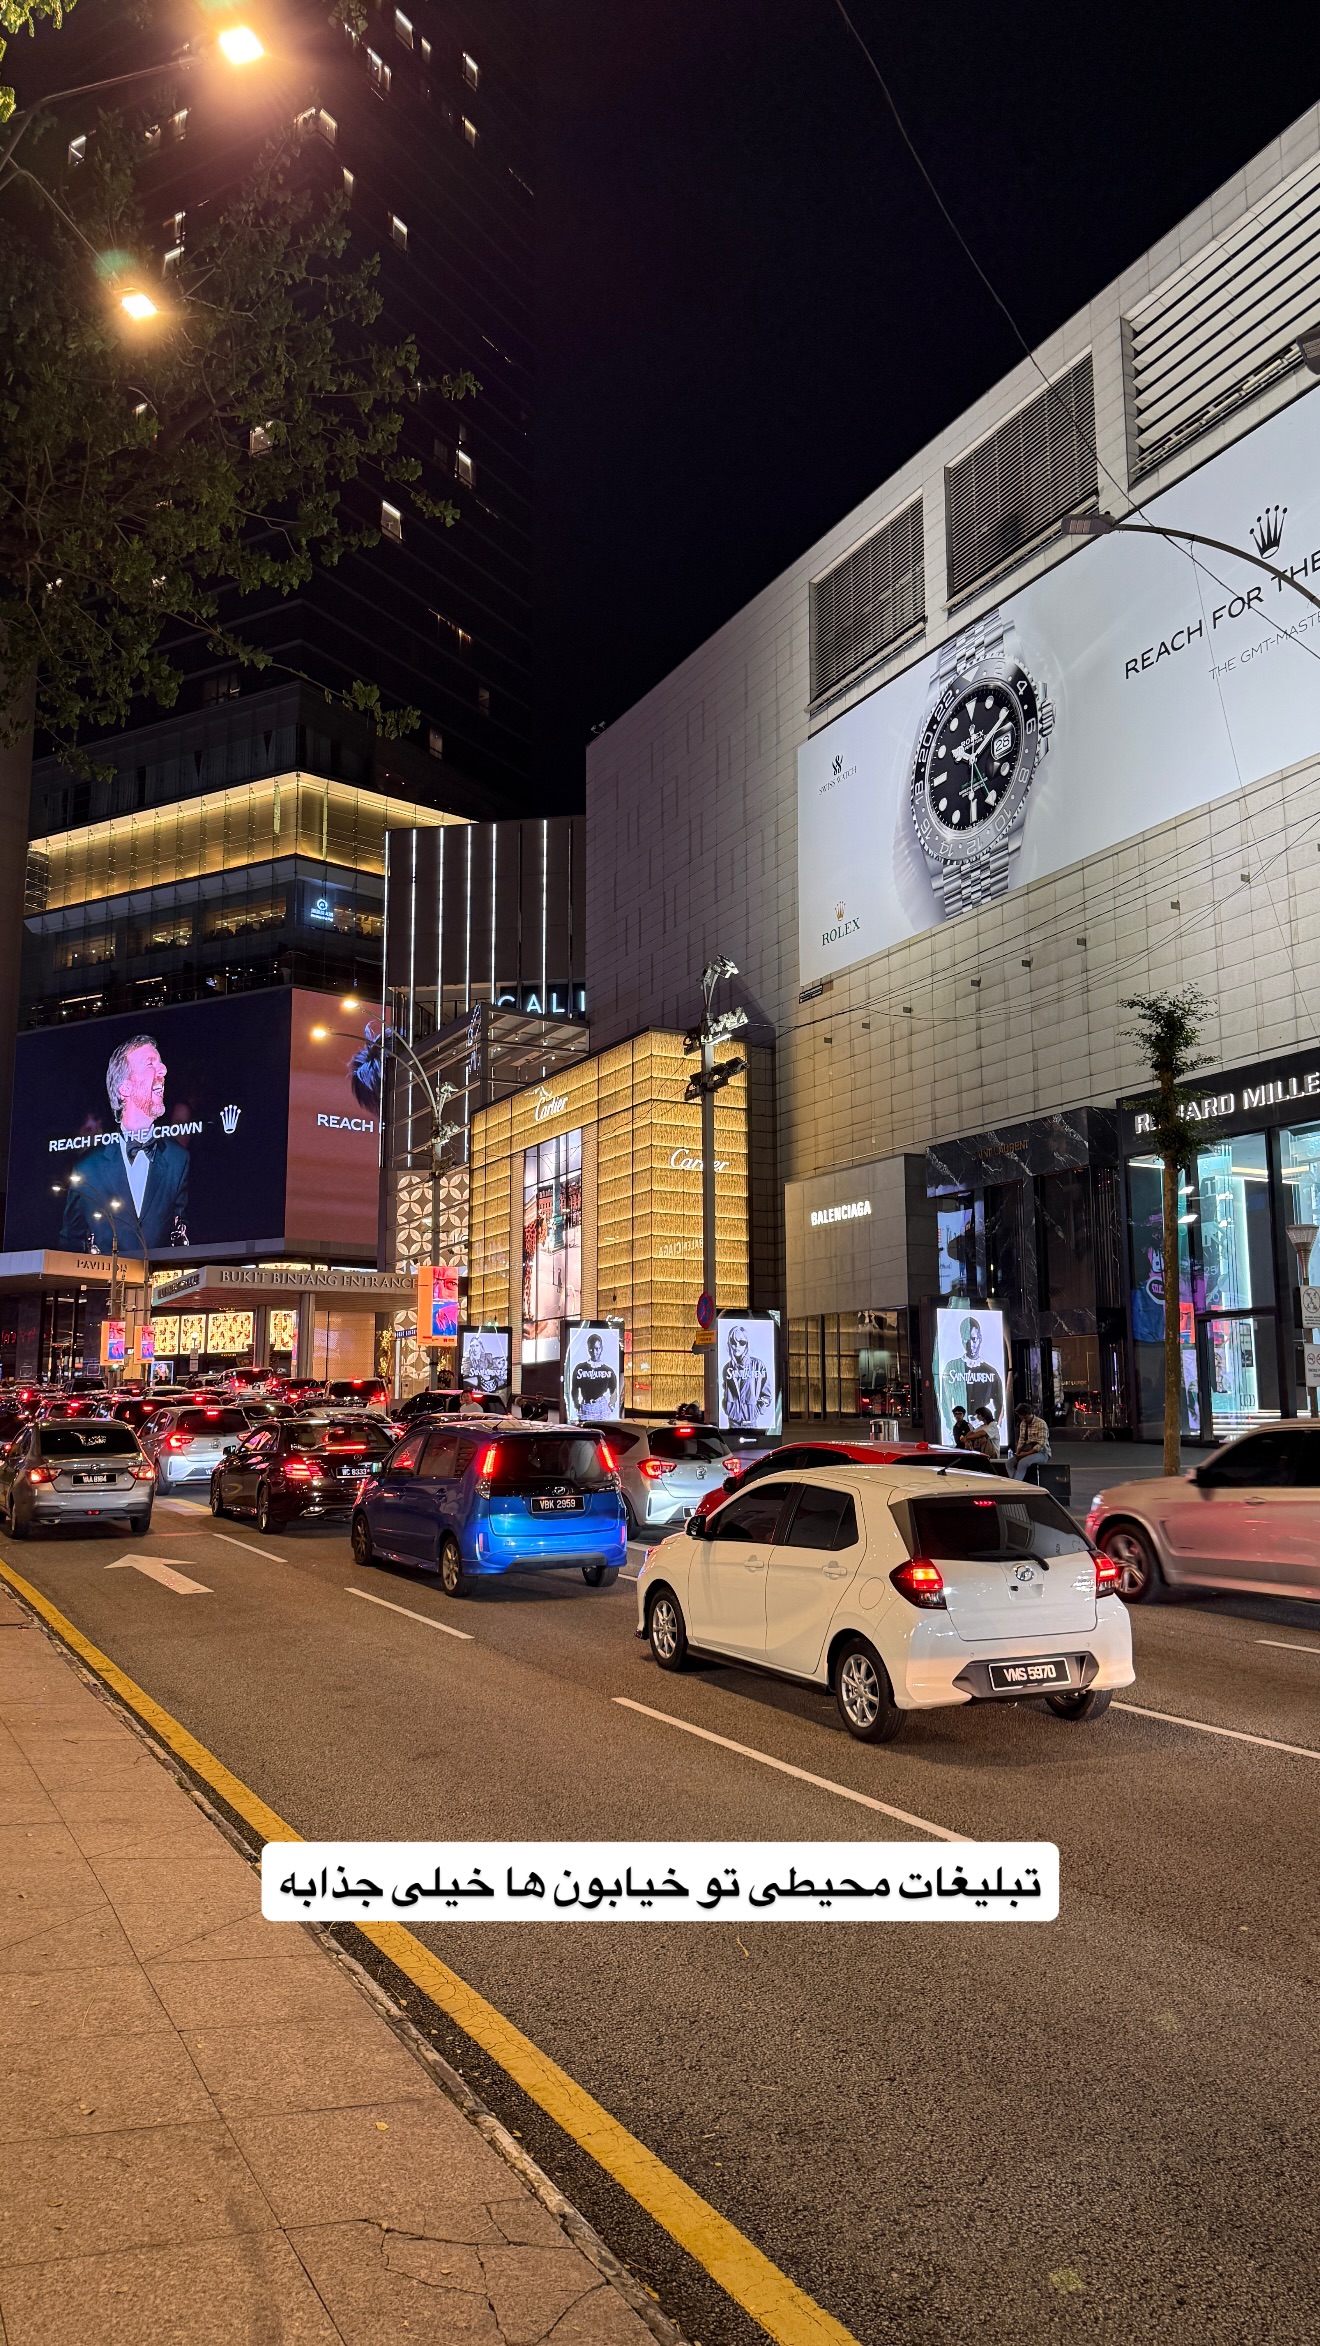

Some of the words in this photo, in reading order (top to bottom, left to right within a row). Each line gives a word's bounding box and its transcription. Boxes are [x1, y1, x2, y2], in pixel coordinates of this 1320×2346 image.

[1125, 619, 1203, 680] REACH
[1212, 586, 1264, 629] FOR
[1208, 657, 1236, 680] THE
[1241, 611, 1320, 663] GMT-MAST
[1016, 680, 1028, 696] 4
[935, 690, 955, 722] 22
[918, 732, 934, 763] 20
[995, 738, 1010, 752] 28
[821, 917, 861, 947] ROLEX
[535, 1096, 569, 1122] Cartier
[317, 1113, 374, 1133] REACH
[48, 1135, 91, 1152] REACH
[94, 1133, 120, 1147] FOR
[124, 1128, 150, 1141] THE
[152, 1121, 203, 1139] CROWN
[670, 1148, 730, 1172] Carer
[810, 1200, 872, 1227] BALENCIAGA
[220, 1270, 269, 1284] BUKIT
[273, 1271, 338, 1286] BINTANG
[341, 1468, 351, 1476] WC
[539, 1500, 555, 1510] VBK
[556, 1499, 576, 1509] 2959
[1003, 1667, 1027, 1682] VMS
[1027, 1664, 1057, 1680] 5970
